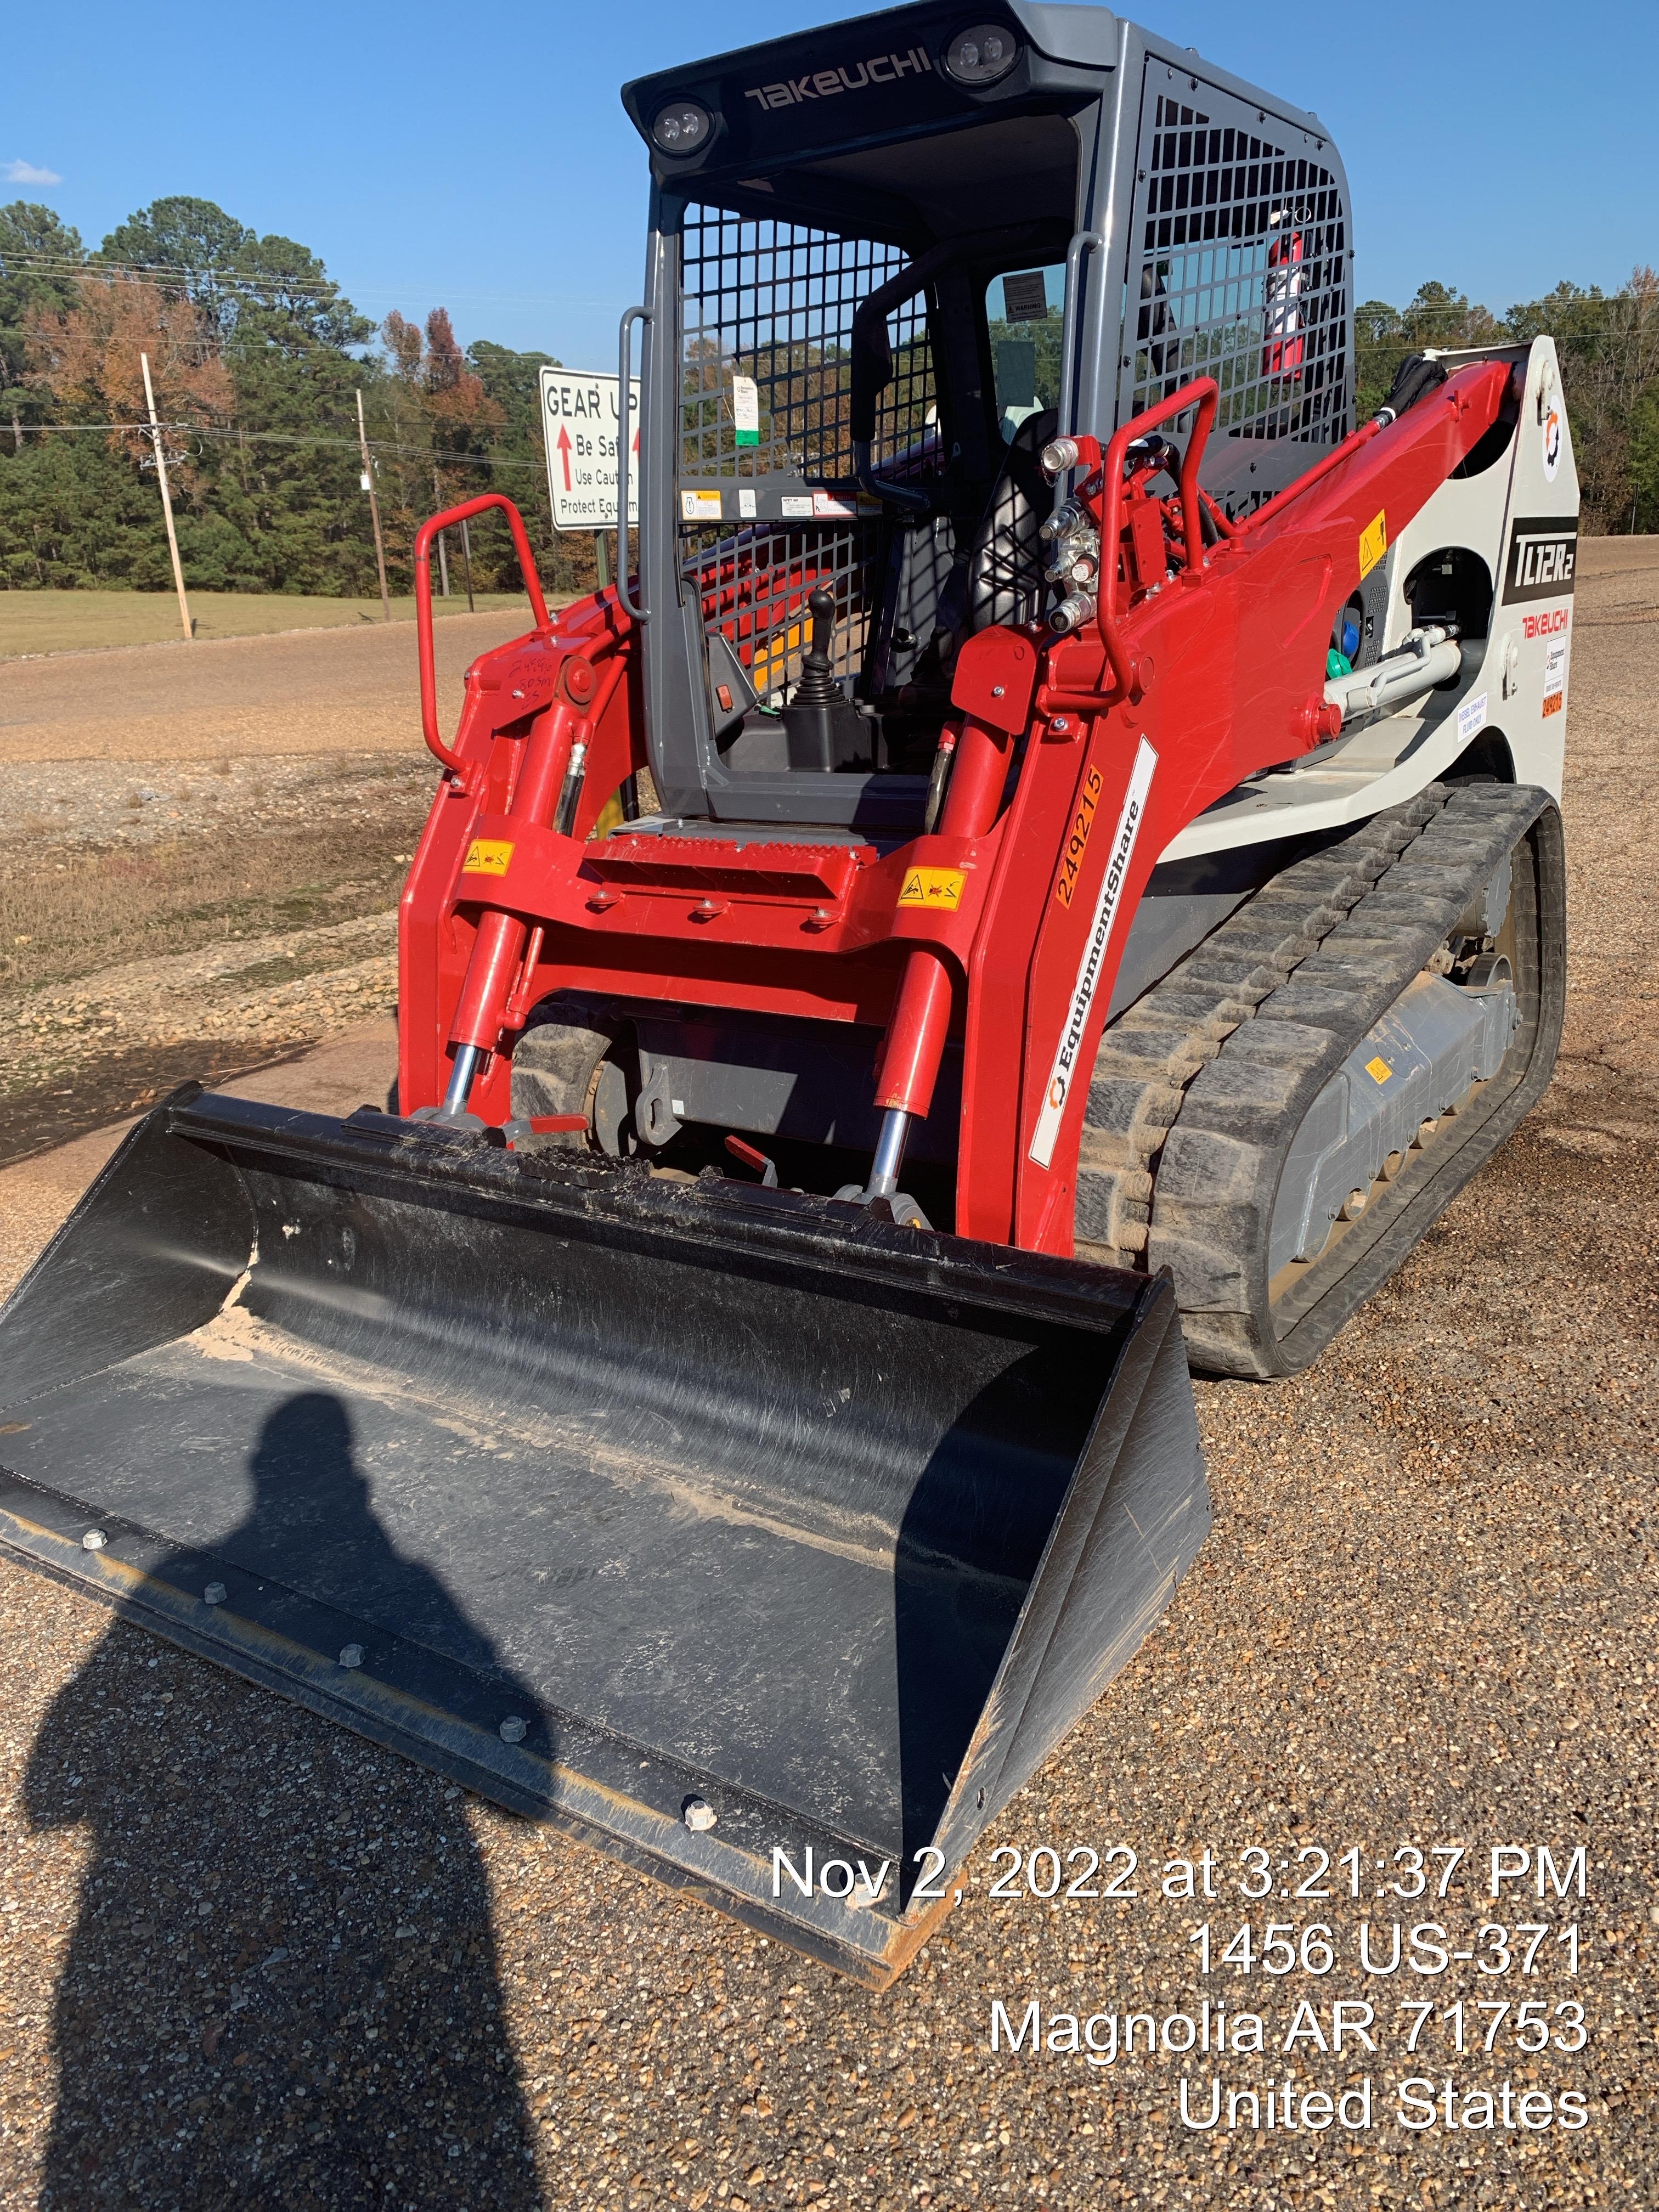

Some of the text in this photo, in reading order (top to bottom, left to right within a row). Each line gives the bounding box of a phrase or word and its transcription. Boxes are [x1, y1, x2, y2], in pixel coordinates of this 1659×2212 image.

[744, 47, 932, 110] TAKEUCHI
[1015, 302, 1041, 311] WARNING
[547, 385, 601, 419] GEAR
[576, 434, 592, 456] Be
[575, 468, 633, 485] Use Cautn
[561, 498, 596, 514] Protect
[1522, 609, 1568, 639] TAKEUCHI
[1458, 696, 1486, 723] DIESEL EXHAUST
[1543, 691, 1562, 718] 249215
[1463, 714, 1481, 734] FLUID ONLY
[1058, 768, 1101, 905] 249215
[1059, 800, 1139, 1070] EquipmentShare
